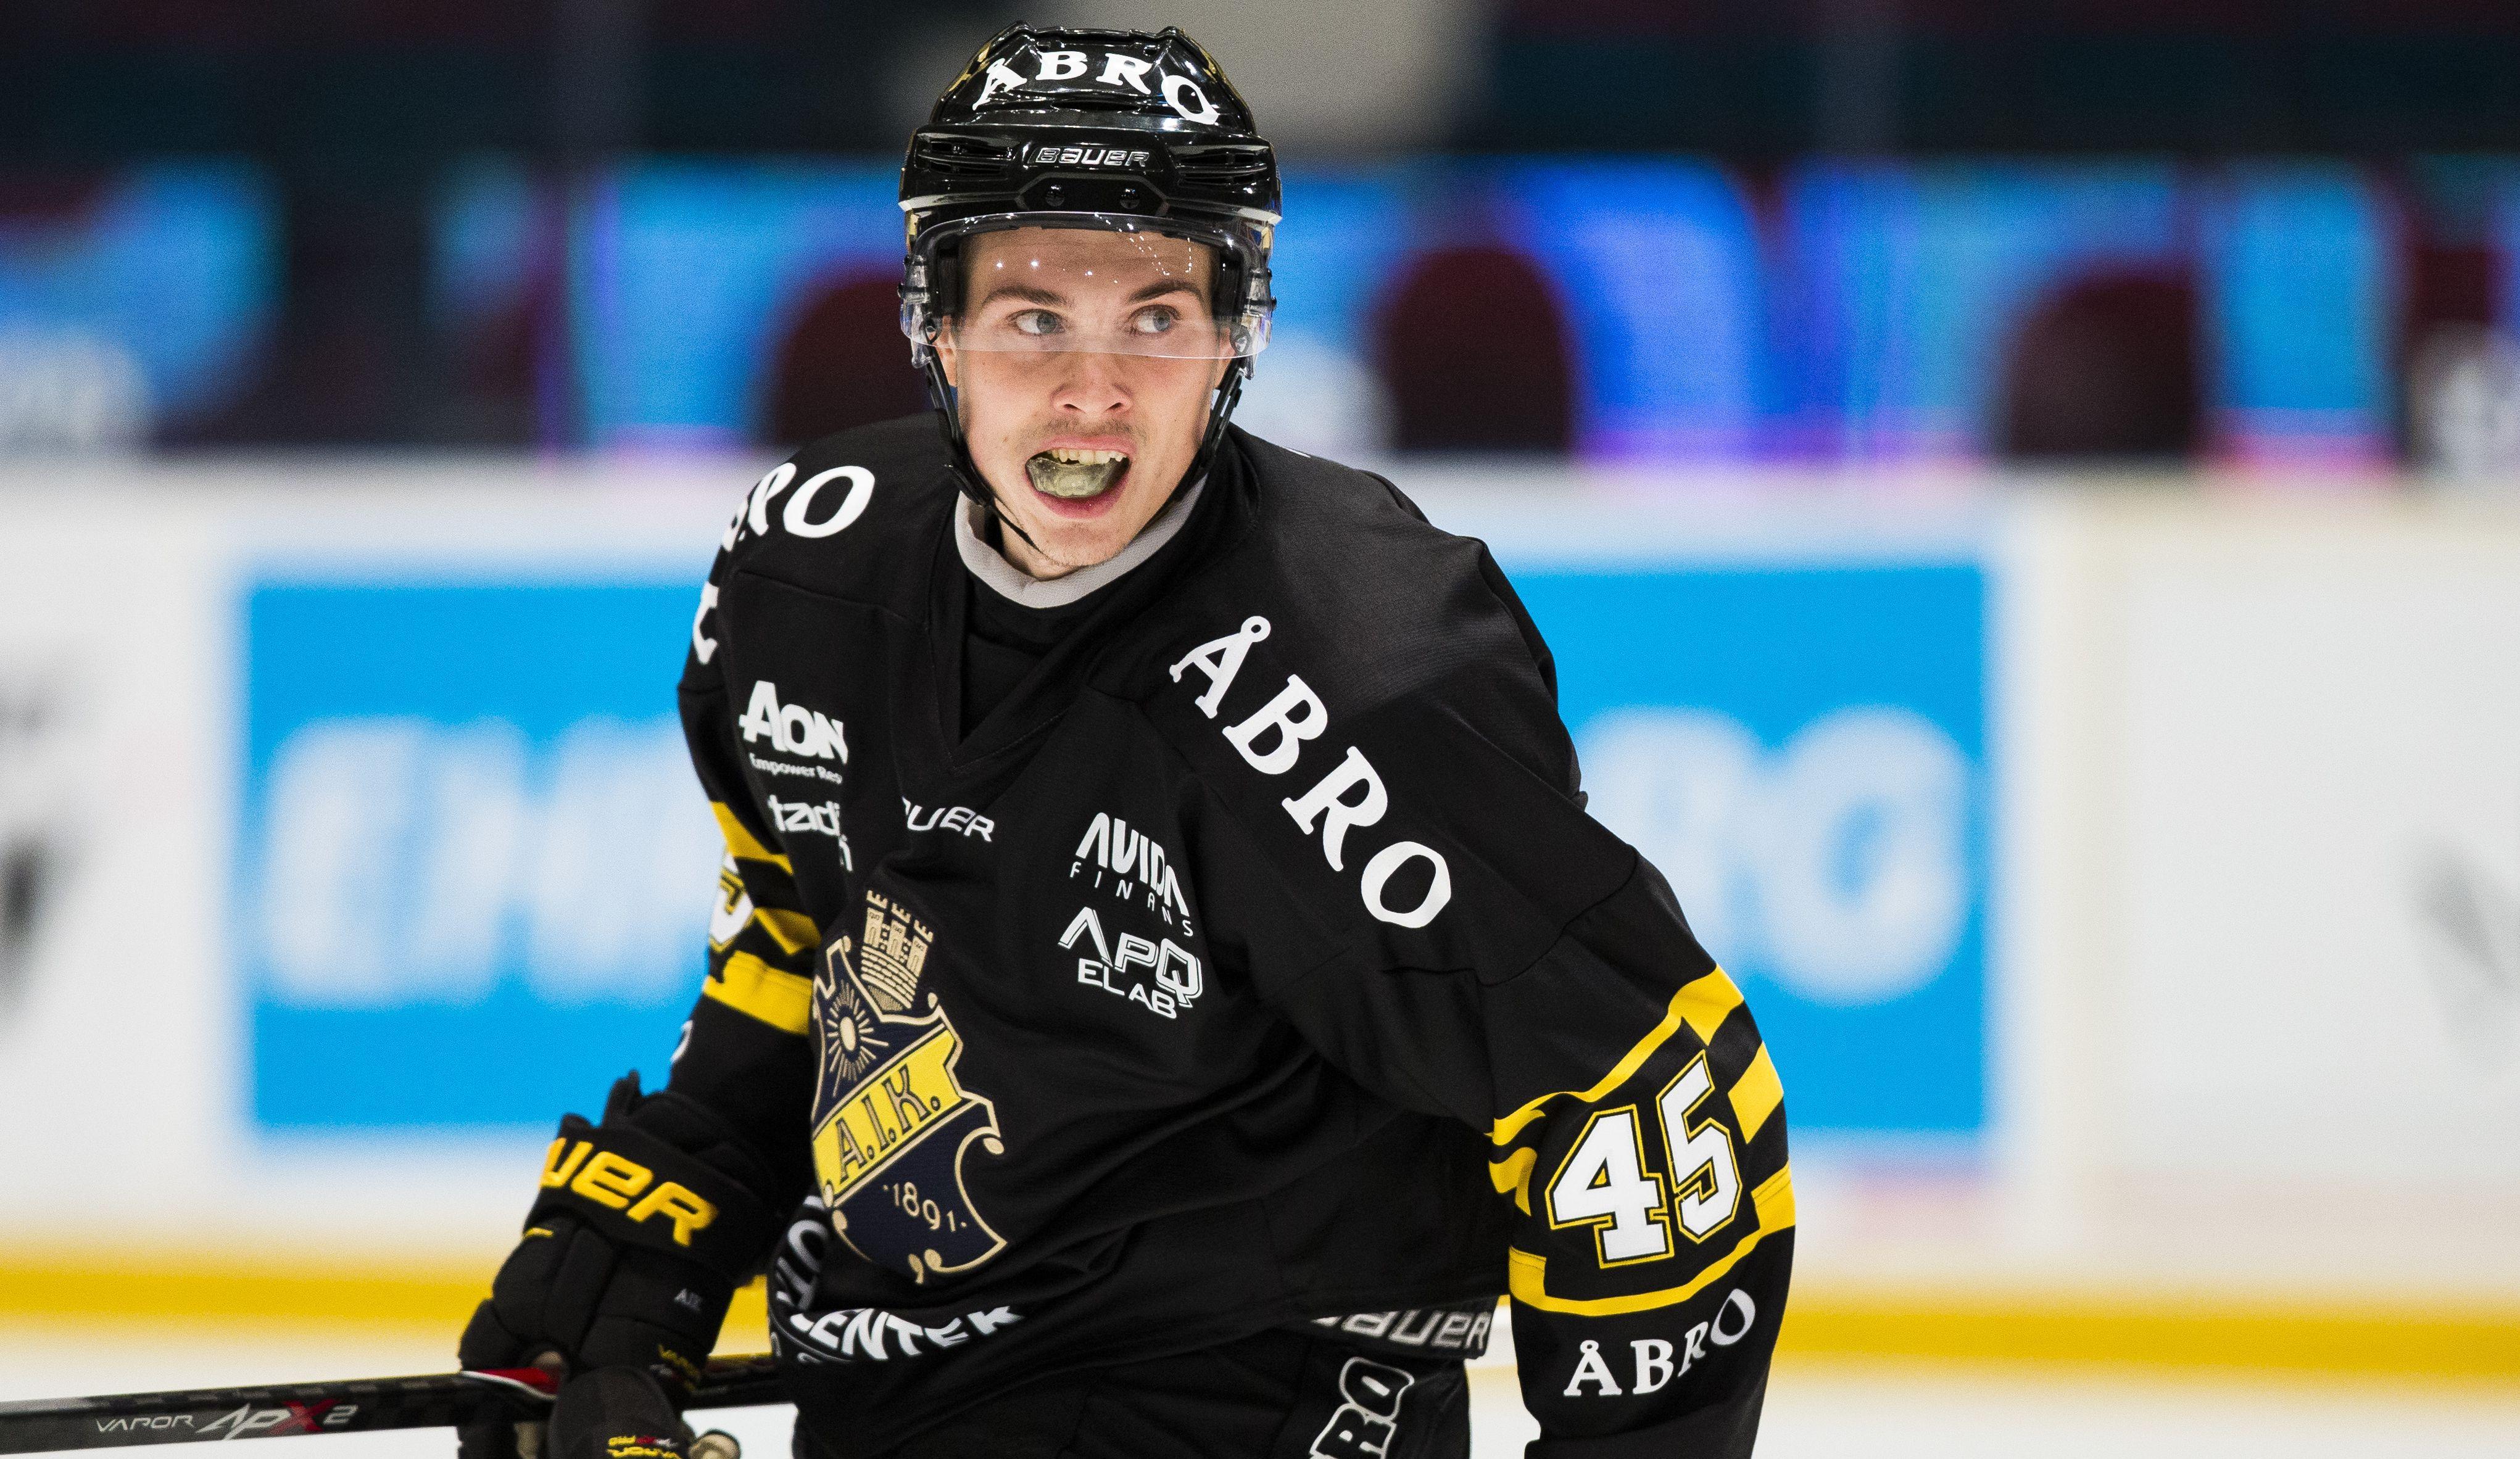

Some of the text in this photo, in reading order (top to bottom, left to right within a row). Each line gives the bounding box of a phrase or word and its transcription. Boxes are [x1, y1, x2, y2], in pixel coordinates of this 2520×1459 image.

[1169, 616, 1451, 928] ÅBRO
[901, 795, 995, 842] UER
[1069, 861, 1193, 936] FINANS
[1076, 812, 1190, 917] AVIDA
[1058, 907, 1203, 1008] APQ
[1078, 957, 1177, 1019] ELAB
[1545, 1050, 1743, 1270] 45
[1309, 1309, 1493, 1350] AUER
[1563, 1288, 1755, 1397] ÅBRO
[95, 1414, 196, 1432] VAPOR
